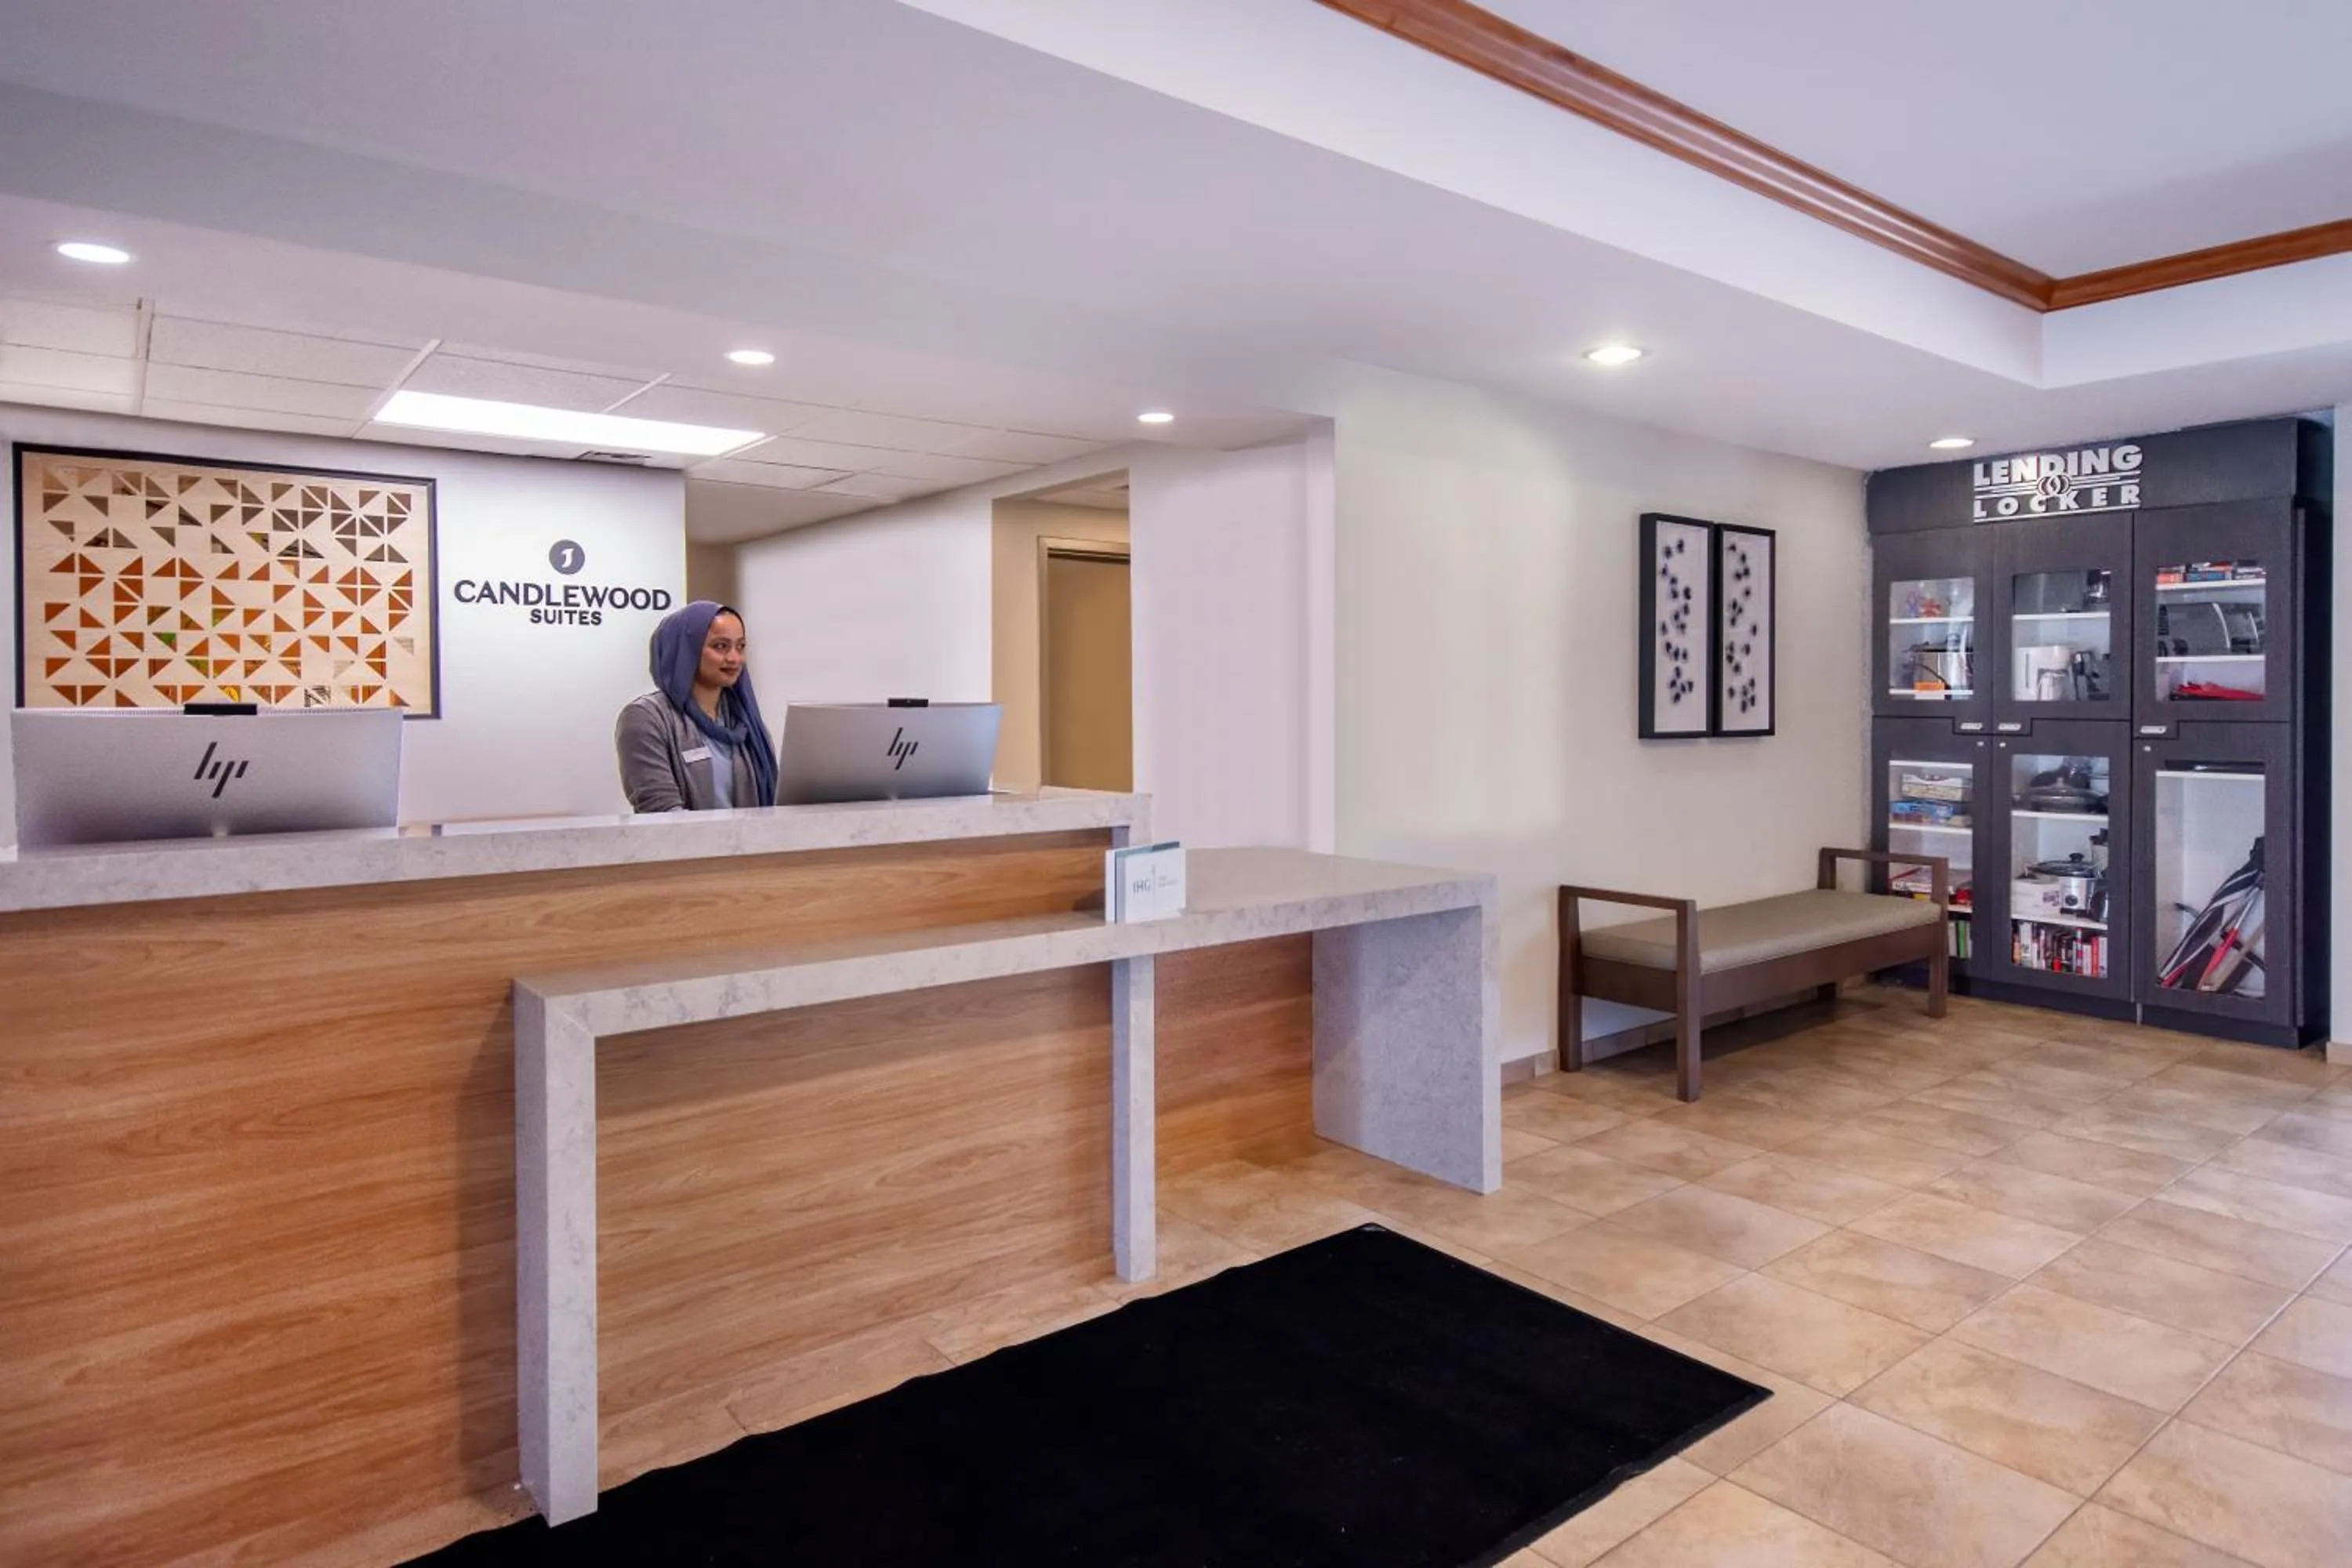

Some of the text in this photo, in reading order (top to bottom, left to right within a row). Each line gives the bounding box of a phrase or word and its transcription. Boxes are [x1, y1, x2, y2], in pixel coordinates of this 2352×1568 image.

[1973, 444, 2143, 487] LENDING
[1973, 485, 2141, 518] LOCKER
[453, 579, 672, 611] CANDLEWOOD
[530, 608, 603, 626] SUITES
